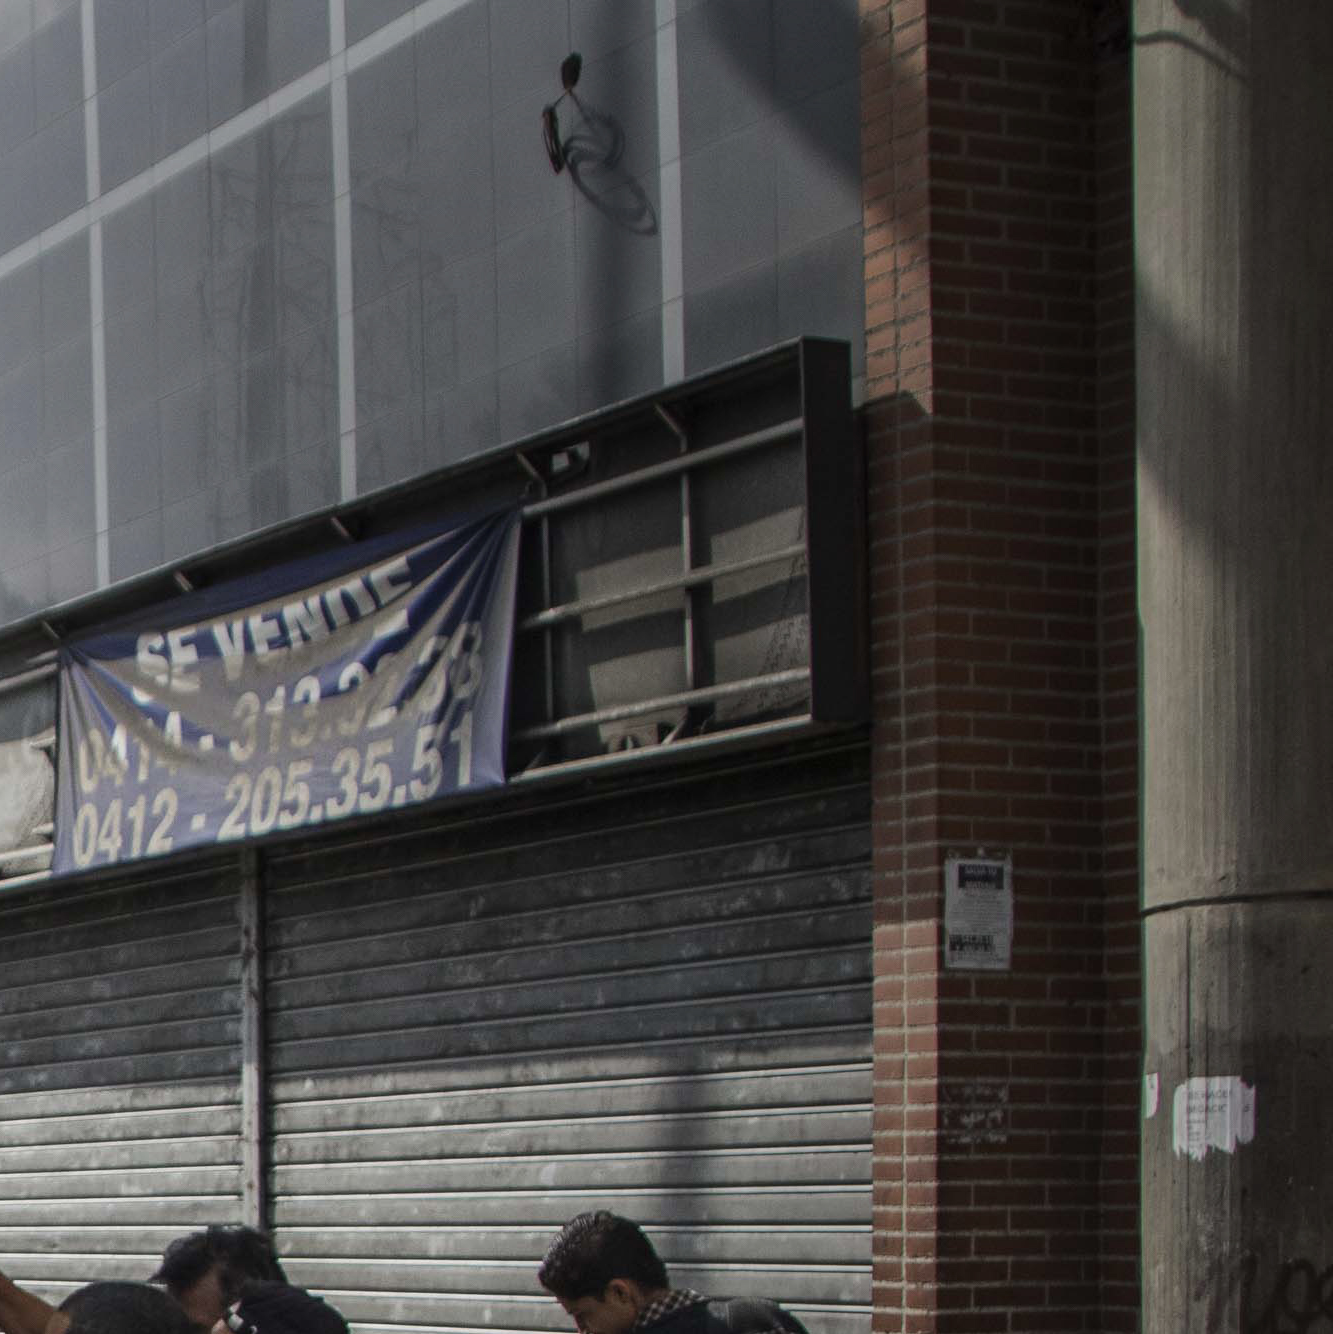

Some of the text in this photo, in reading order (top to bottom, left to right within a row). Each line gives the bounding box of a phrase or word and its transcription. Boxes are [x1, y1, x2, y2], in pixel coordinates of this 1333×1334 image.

[136, 555, 415, 692] SE VENDE
[72, 787, 179, 870] 0412
[217, 711, 474, 842] 205.35.51
